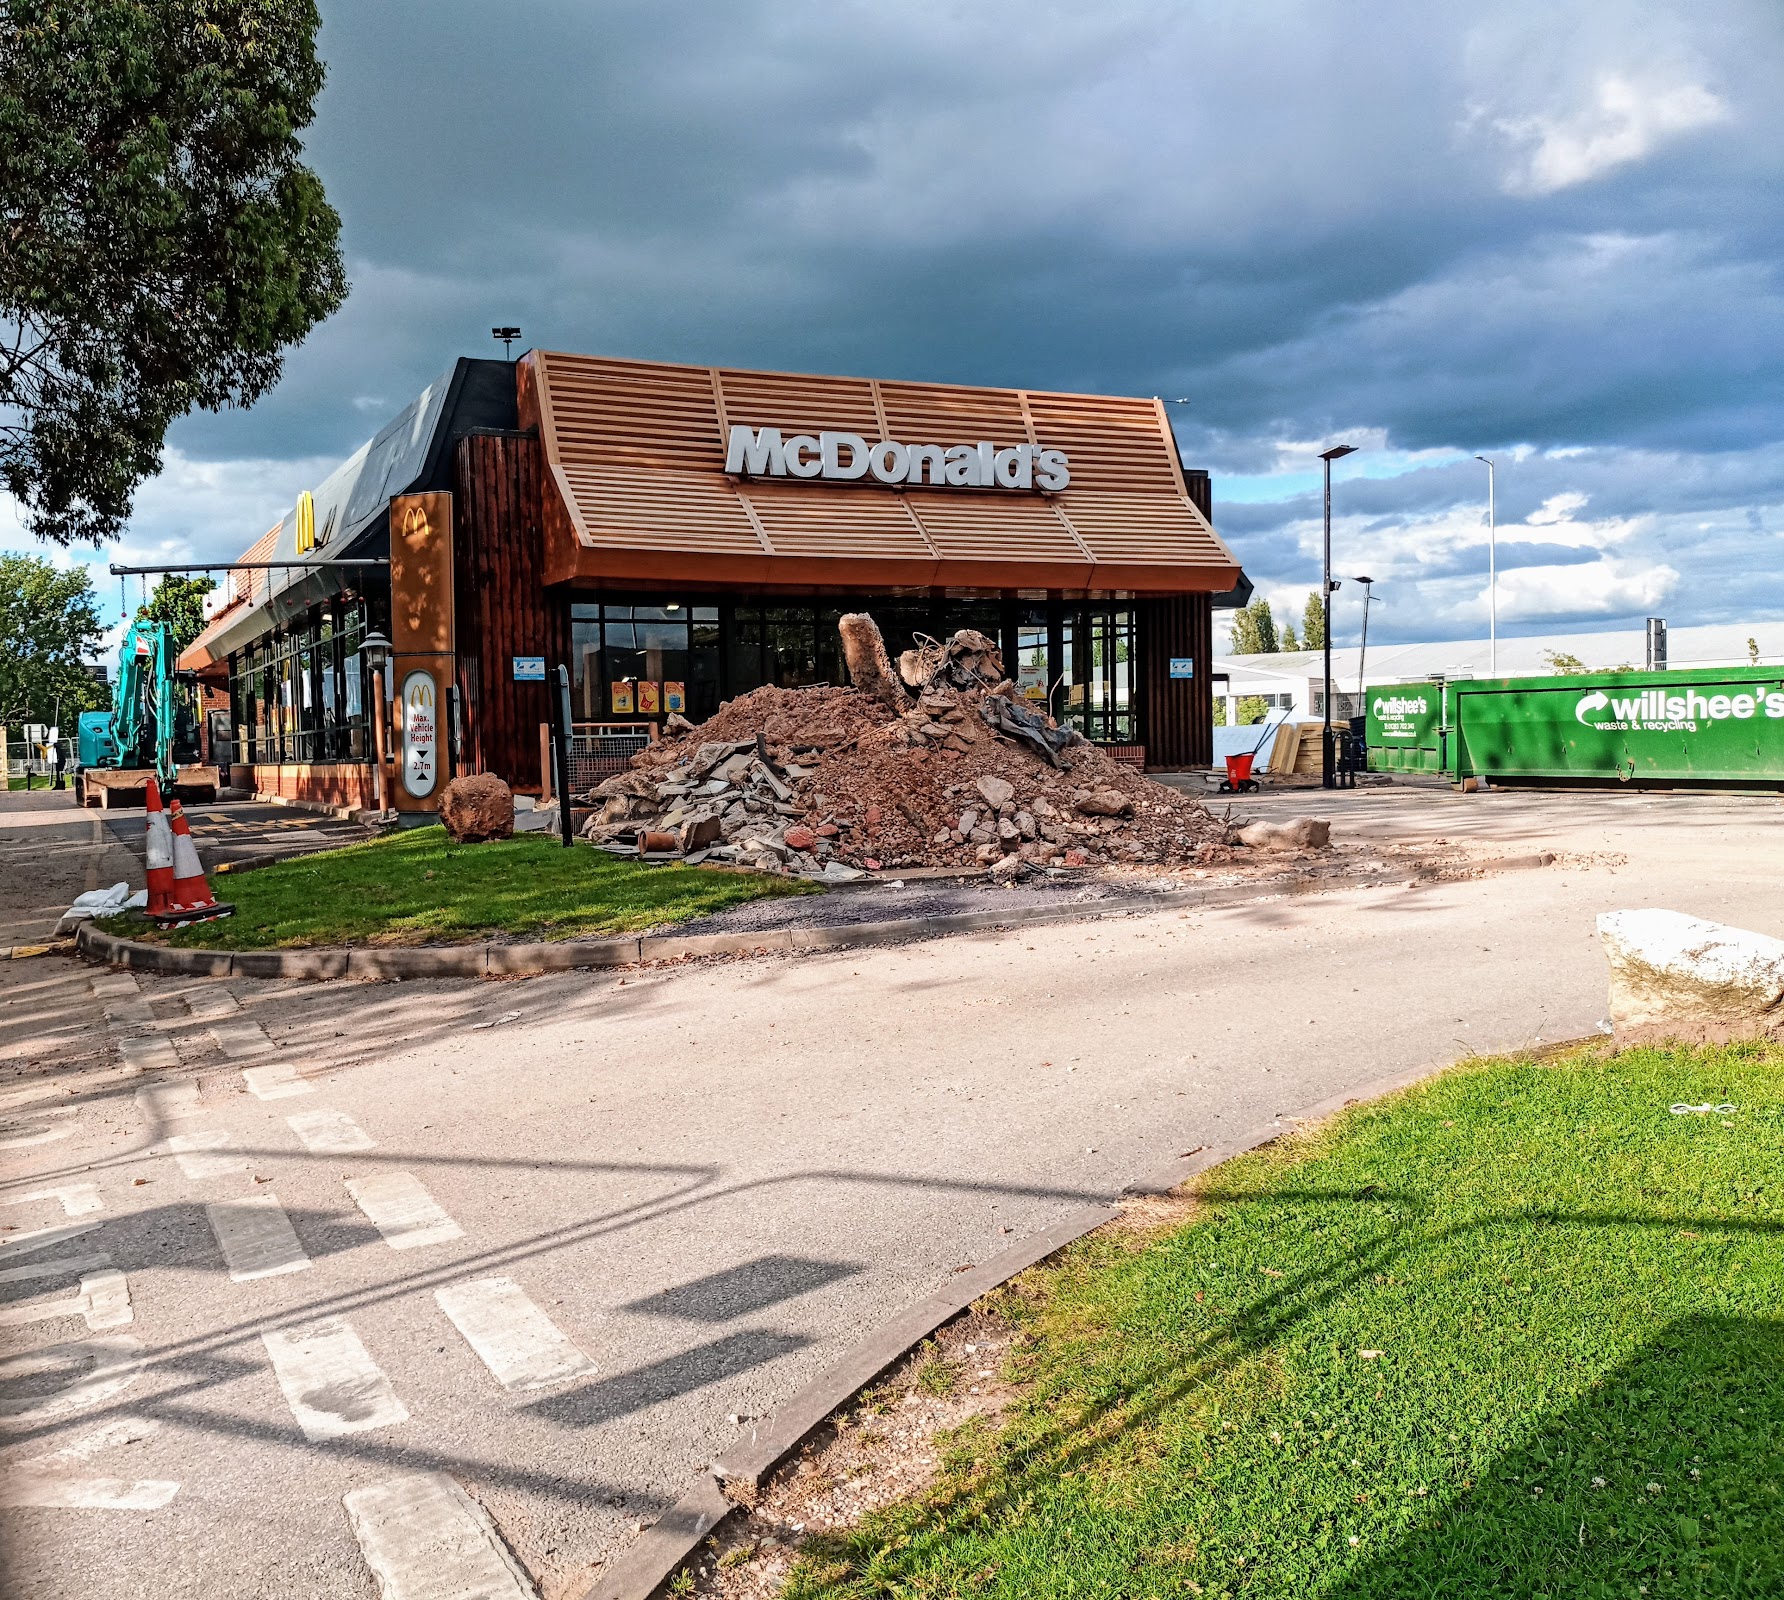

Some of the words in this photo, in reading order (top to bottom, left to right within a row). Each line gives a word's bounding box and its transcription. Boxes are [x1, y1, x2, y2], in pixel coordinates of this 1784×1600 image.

[724, 424, 1071, 491] McDonald's
[1382, 696, 1426, 714] willshee's
[1611, 687, 1784, 720] willshee's
[413, 713, 430, 723] Max.
[410, 723, 434, 733] Vehicle
[1594, 721, 1628, 731] waste
[1631, 720, 1641, 731] &
[1643, 720, 1696, 732] recycling
[410, 733, 433, 744] Height
[413, 761, 431, 770] 2.7m
